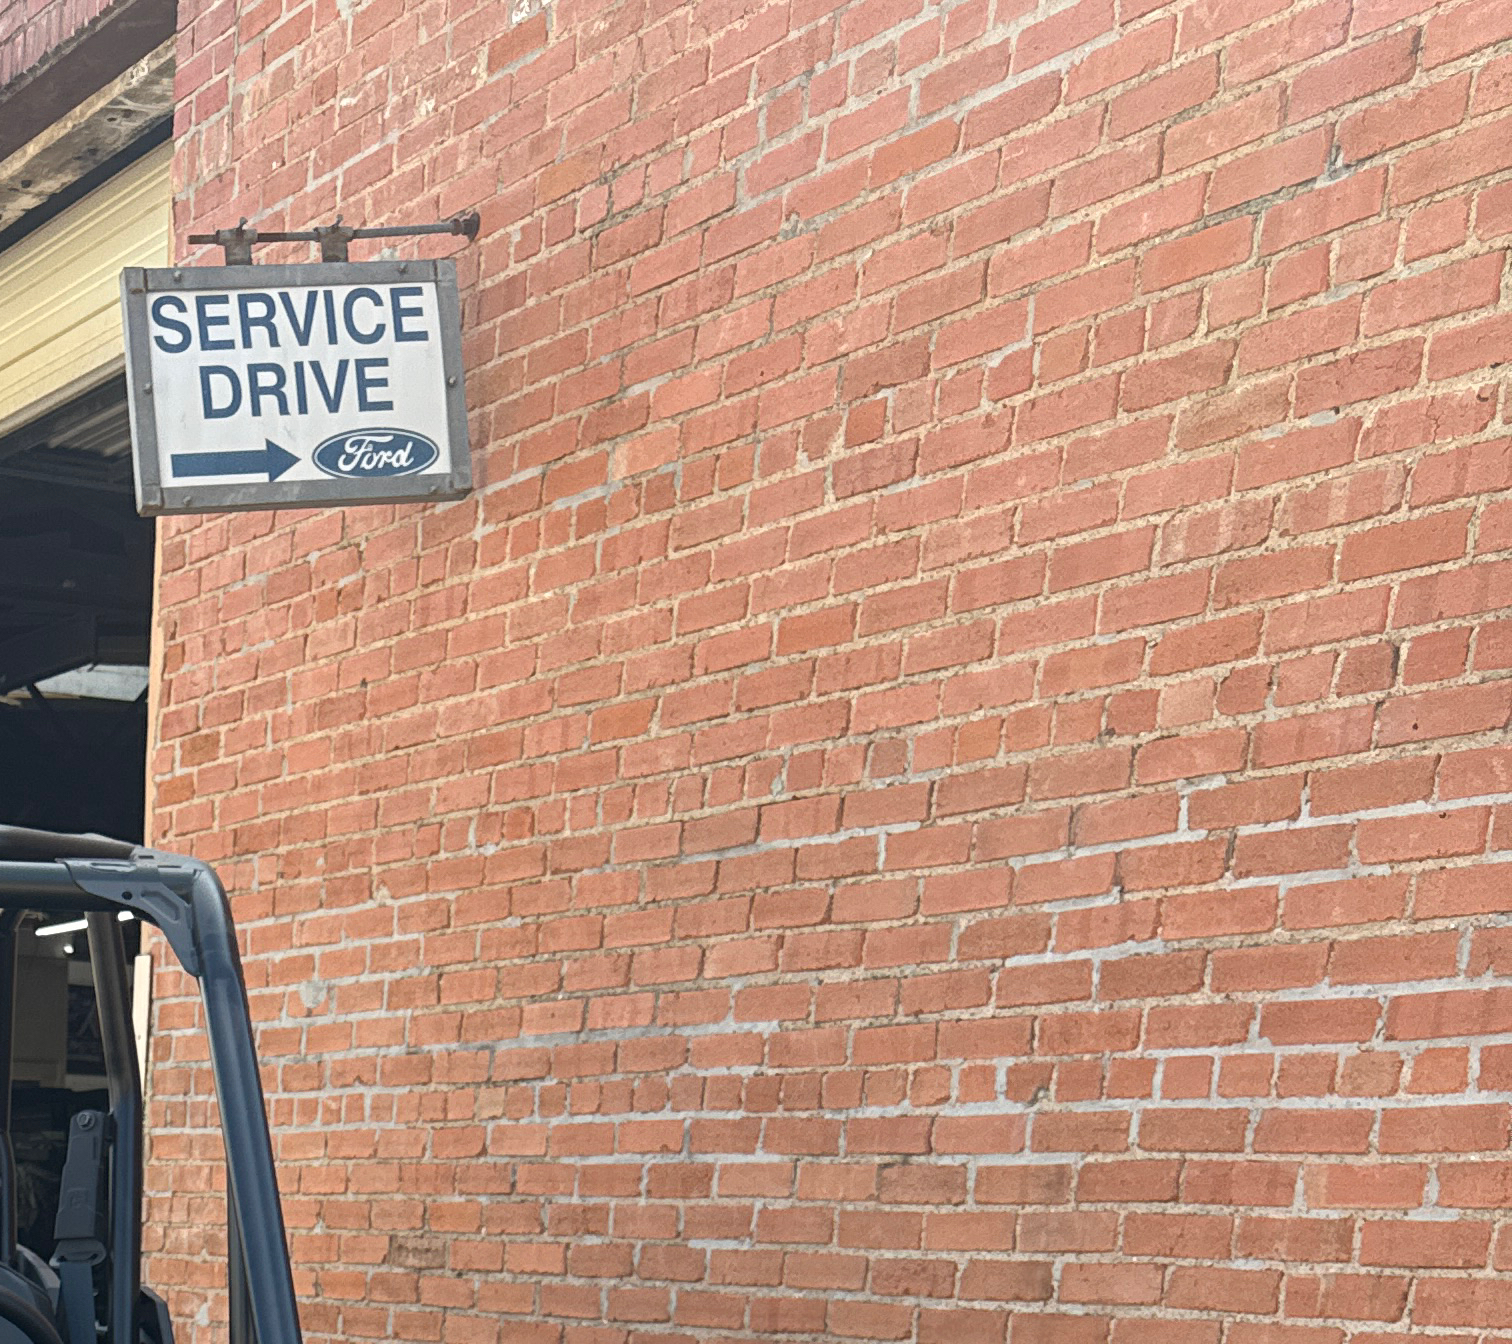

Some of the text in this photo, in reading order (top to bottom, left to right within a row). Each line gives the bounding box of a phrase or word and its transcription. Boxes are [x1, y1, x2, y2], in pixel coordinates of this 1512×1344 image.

[151, 286, 429, 354] SERVICE
[199, 357, 394, 419] DRIVE
[337, 435, 415, 472] Ford
